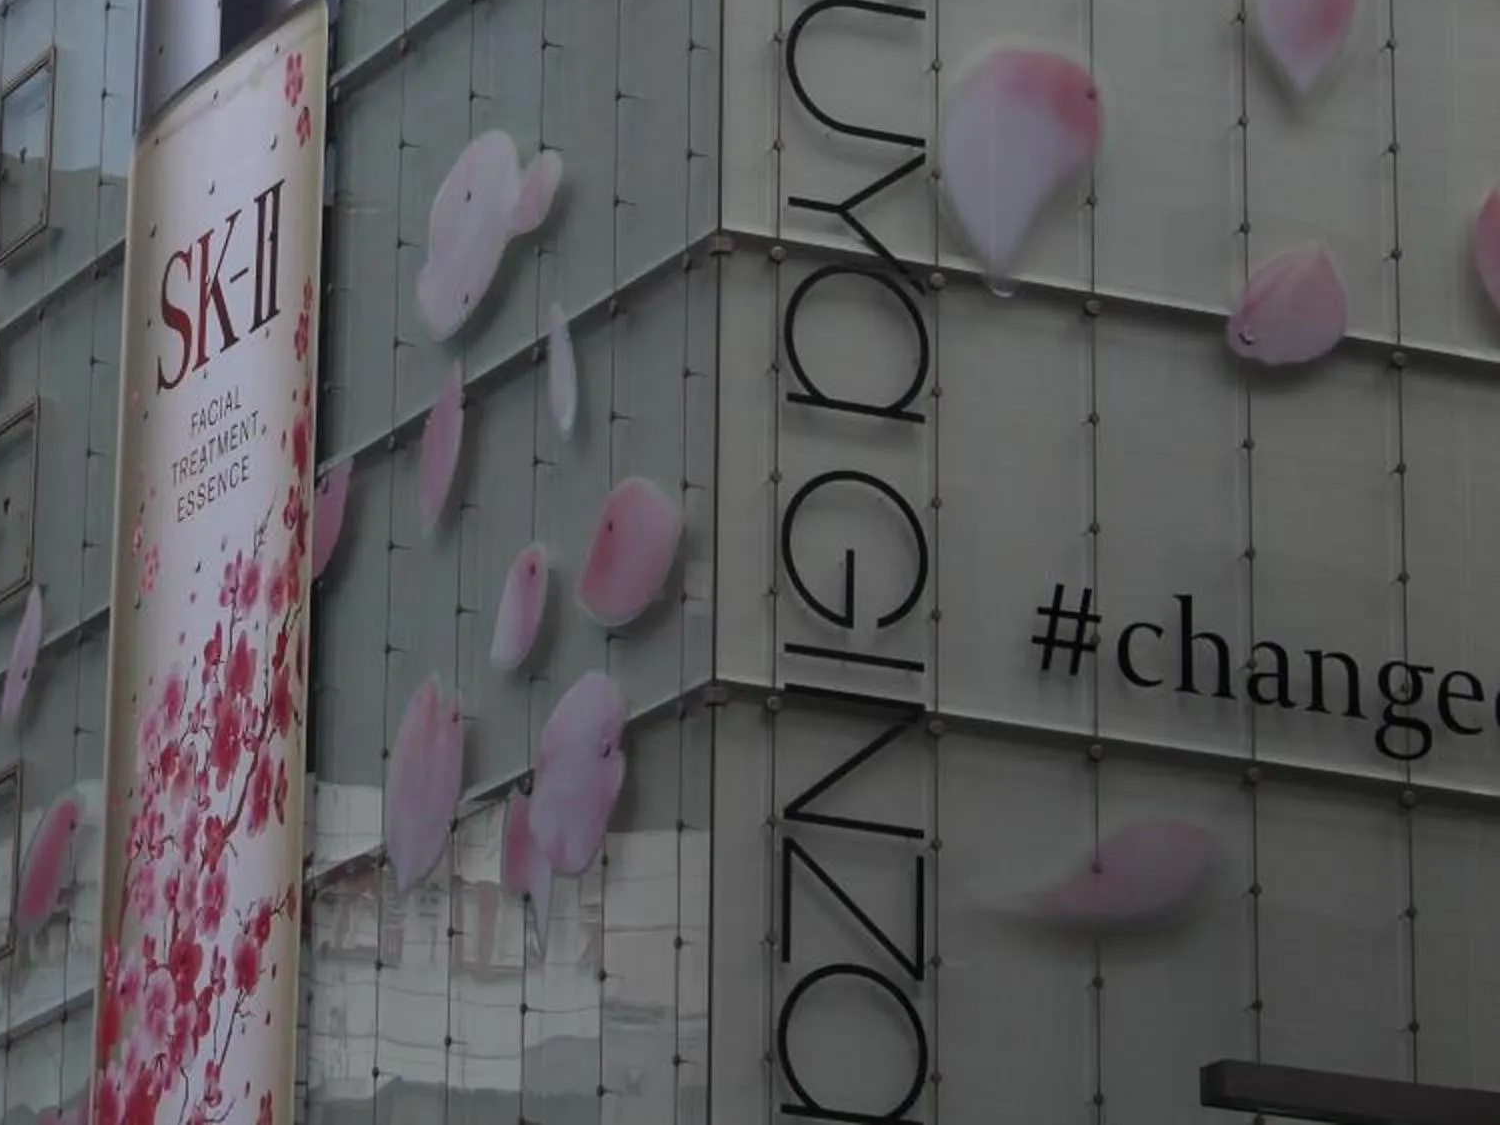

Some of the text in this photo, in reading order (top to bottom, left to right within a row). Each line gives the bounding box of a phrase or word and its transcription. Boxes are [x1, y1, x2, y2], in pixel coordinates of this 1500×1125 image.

[156, 179, 285, 395] SK-II
[171, 410, 259, 487] TREATMENT
[190, 385, 242, 437] FACIAL
[177, 455, 250, 523] ESSENCE
[1031, 583, 1500, 761] #change
